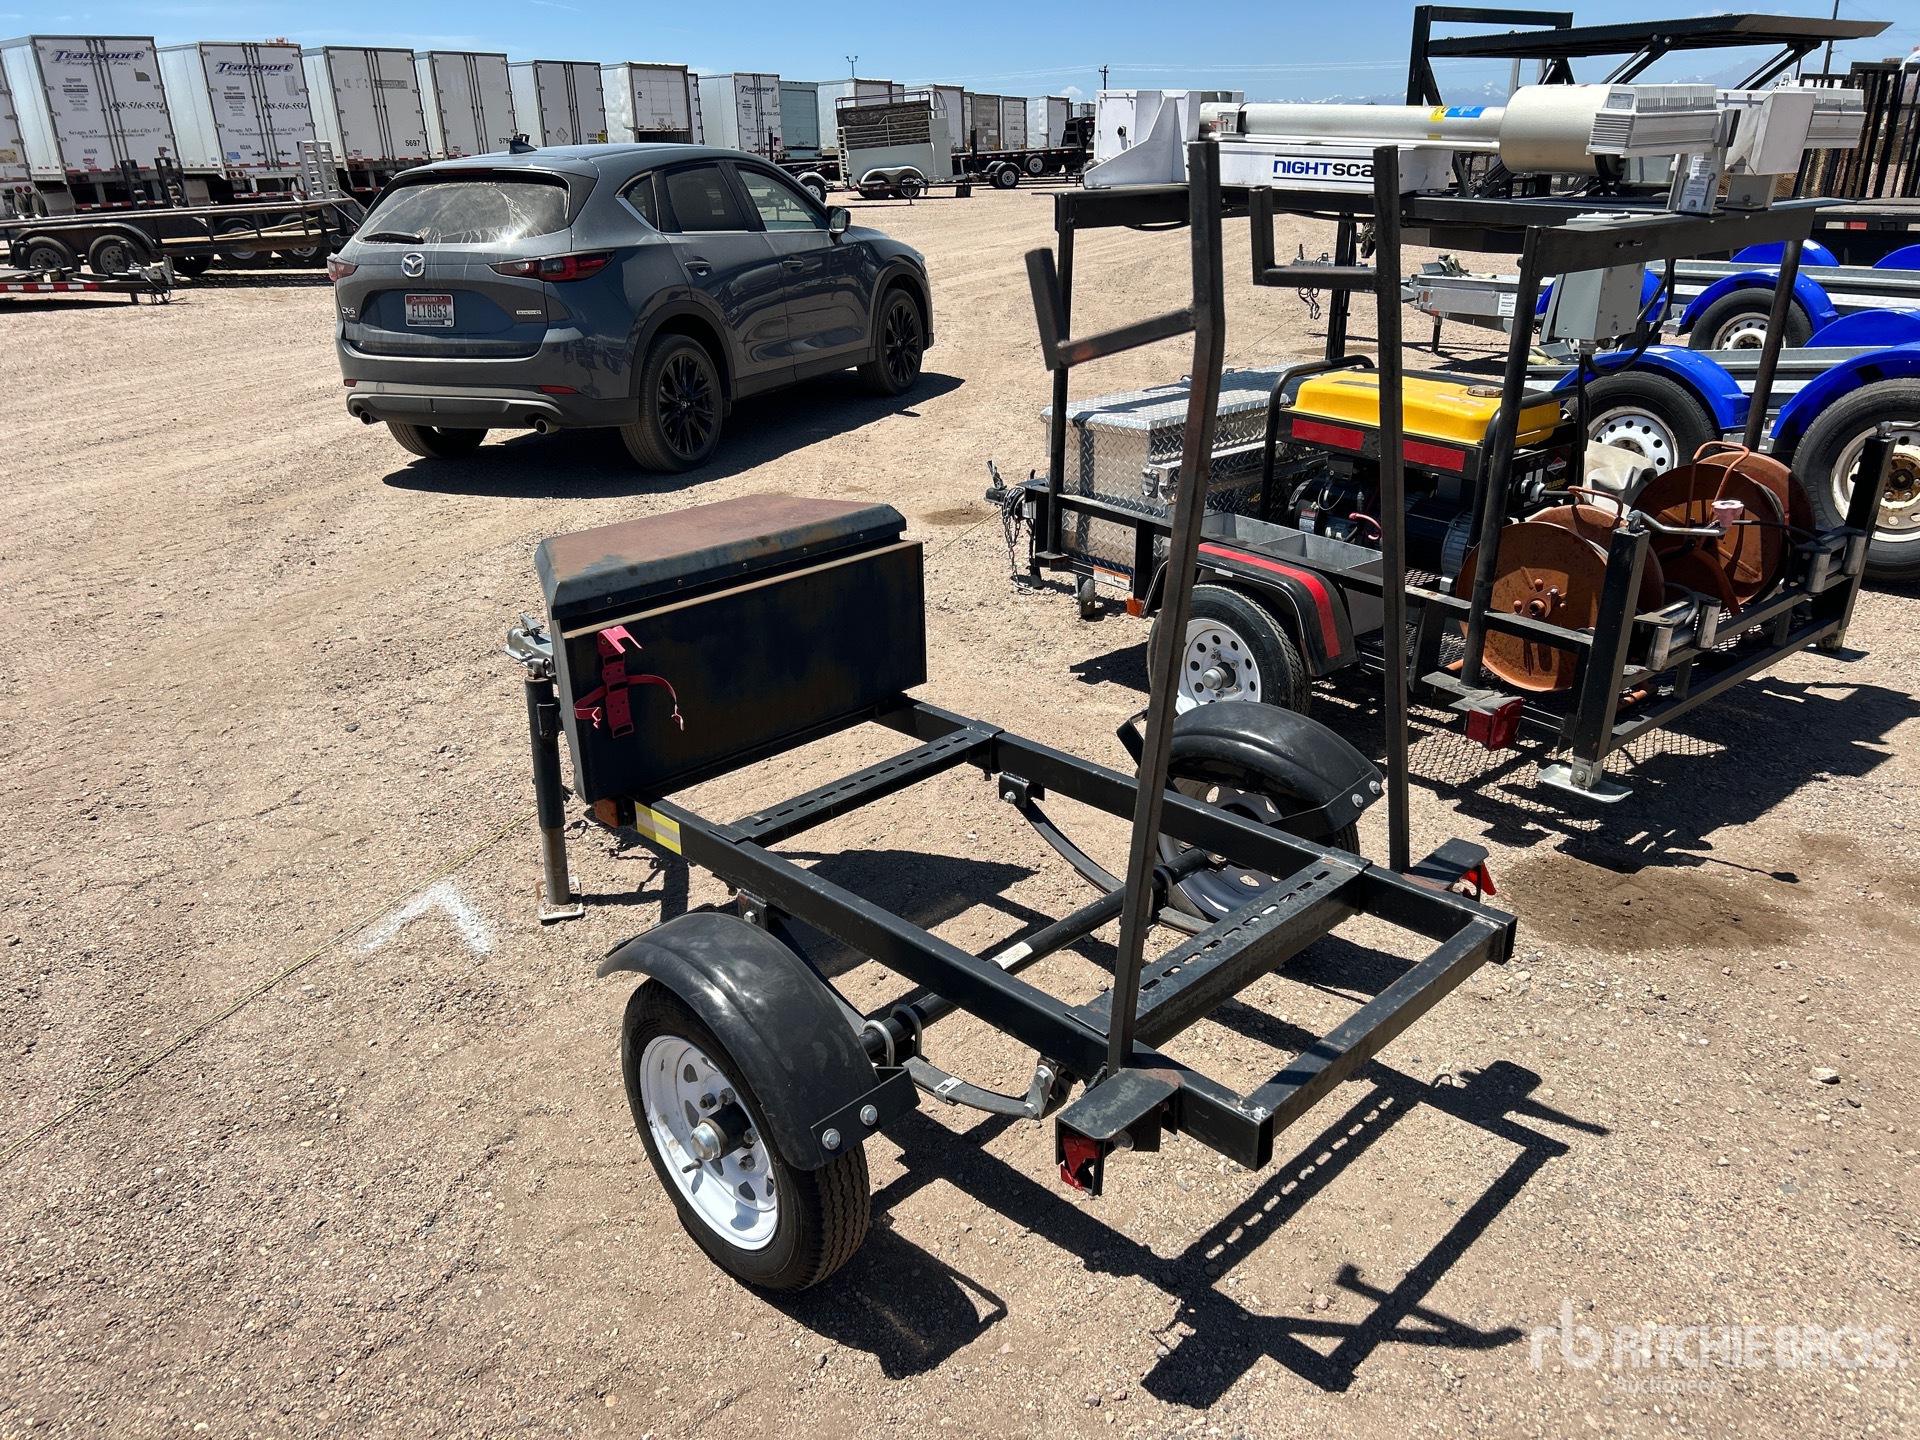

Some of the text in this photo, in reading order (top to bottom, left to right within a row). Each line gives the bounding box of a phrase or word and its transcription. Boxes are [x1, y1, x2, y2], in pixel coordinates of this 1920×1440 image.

[50, 49, 145, 63] Transport
[215, 61, 294, 74] Transport
[405, 139, 421, 147] 5697
[412, 304, 448, 318] FL18953
